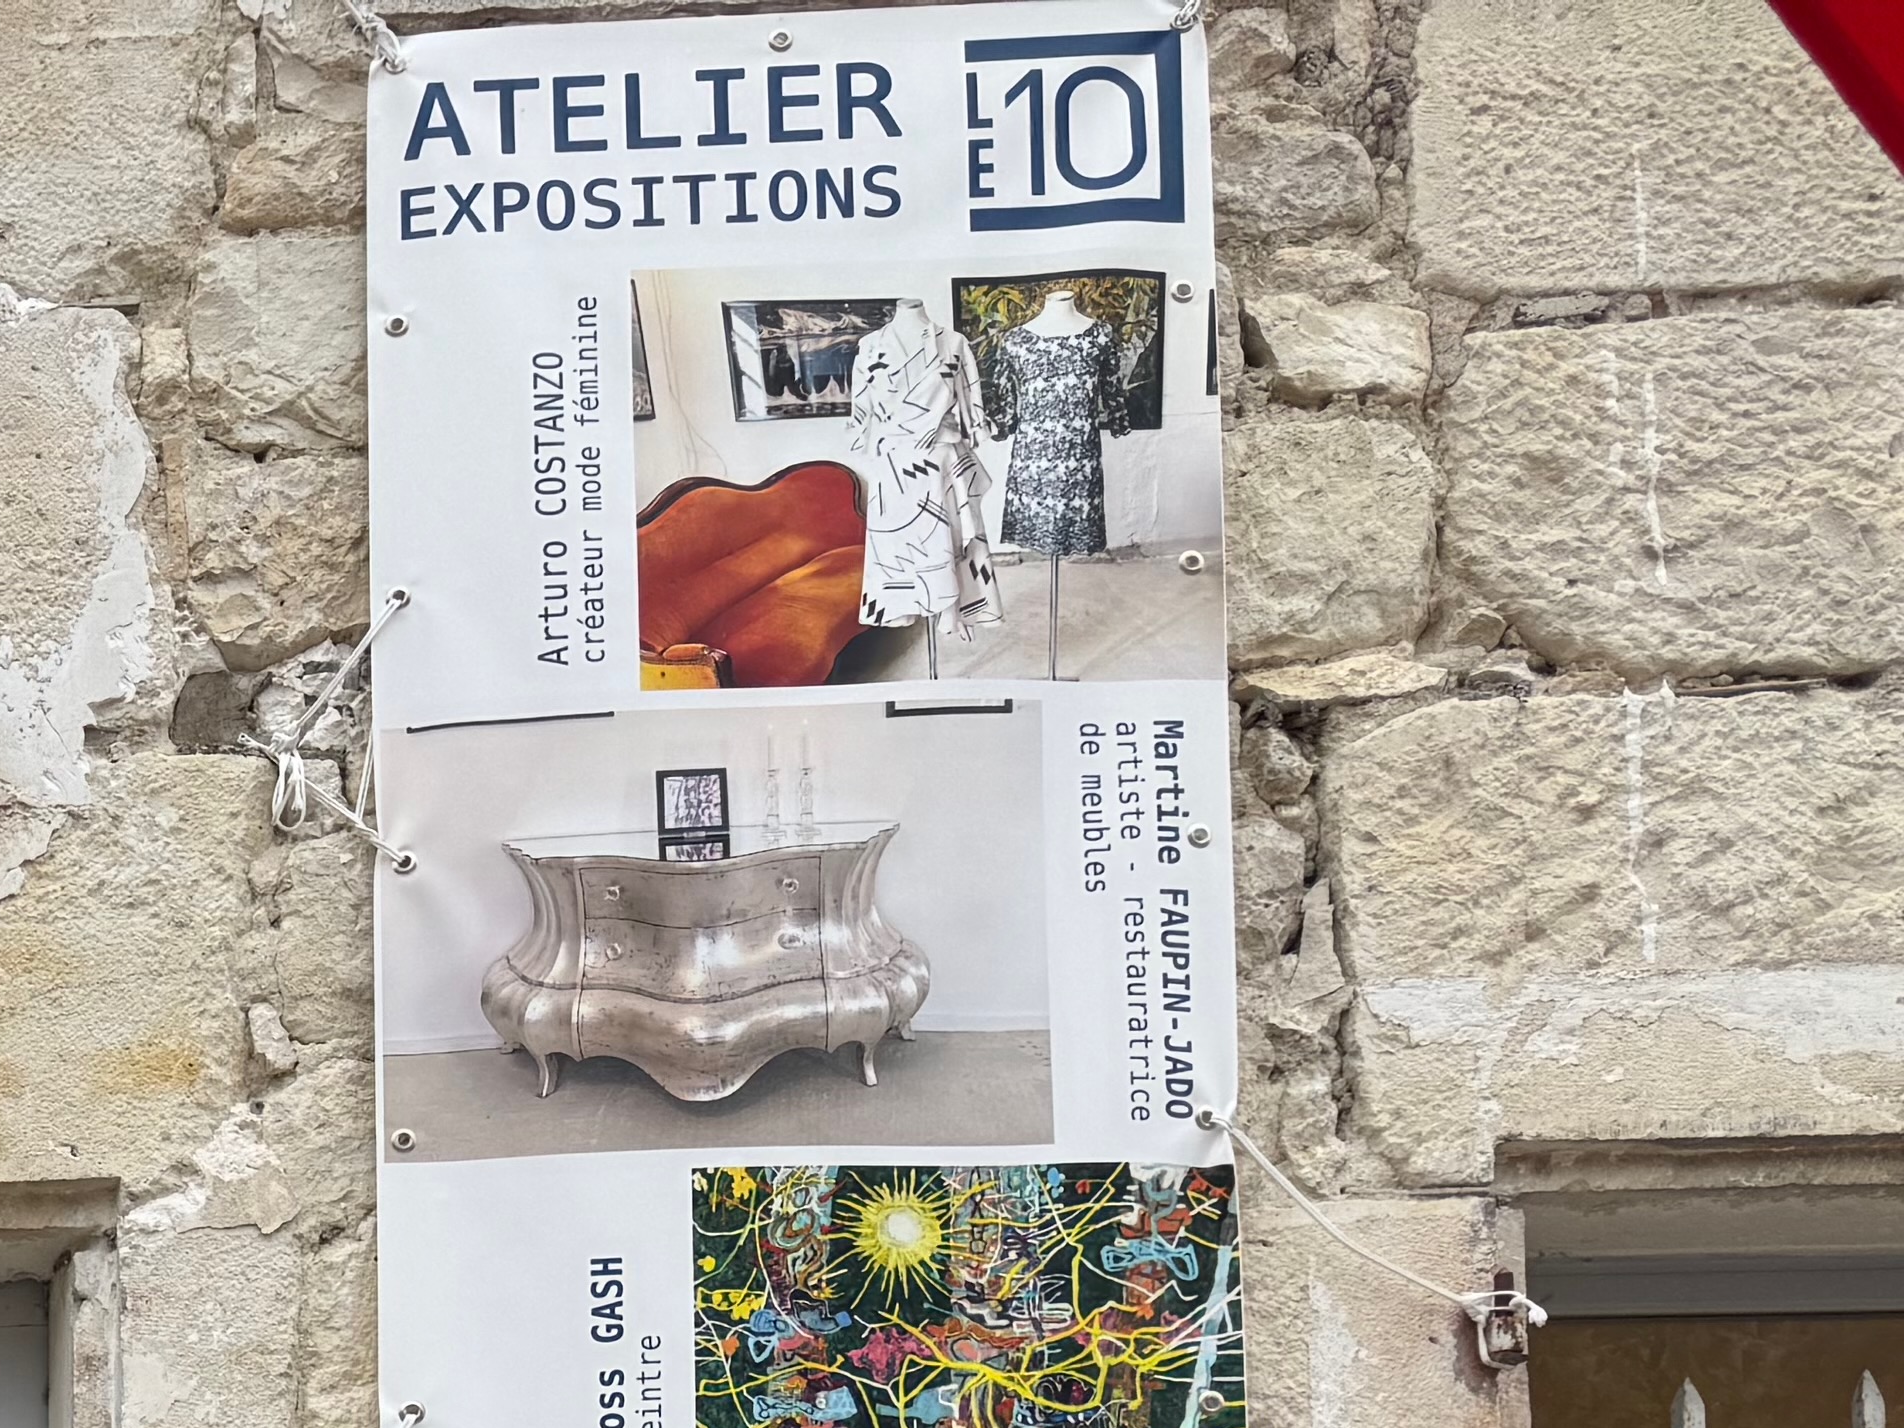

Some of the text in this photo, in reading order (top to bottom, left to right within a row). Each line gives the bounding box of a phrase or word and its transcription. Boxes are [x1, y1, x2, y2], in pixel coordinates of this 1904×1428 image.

[400, 61, 903, 162] ATELIER
[1004, 65, 1148, 196] 10
[400, 164, 902, 241] EXPOSITIONS
[532, 352, 569, 666] Arturo COSTANZO
[571, 296, 605, 663] créateur mode féminine
[1079, 723, 1110, 893] de meubles
[1115, 722, 1143, 840] artiste
[1153, 720, 1197, 1121] Martine FAUPIN-JADO
[1123, 897, 1155, 1121] restauratrice
[590, 1257, 624, 1343] GASH
